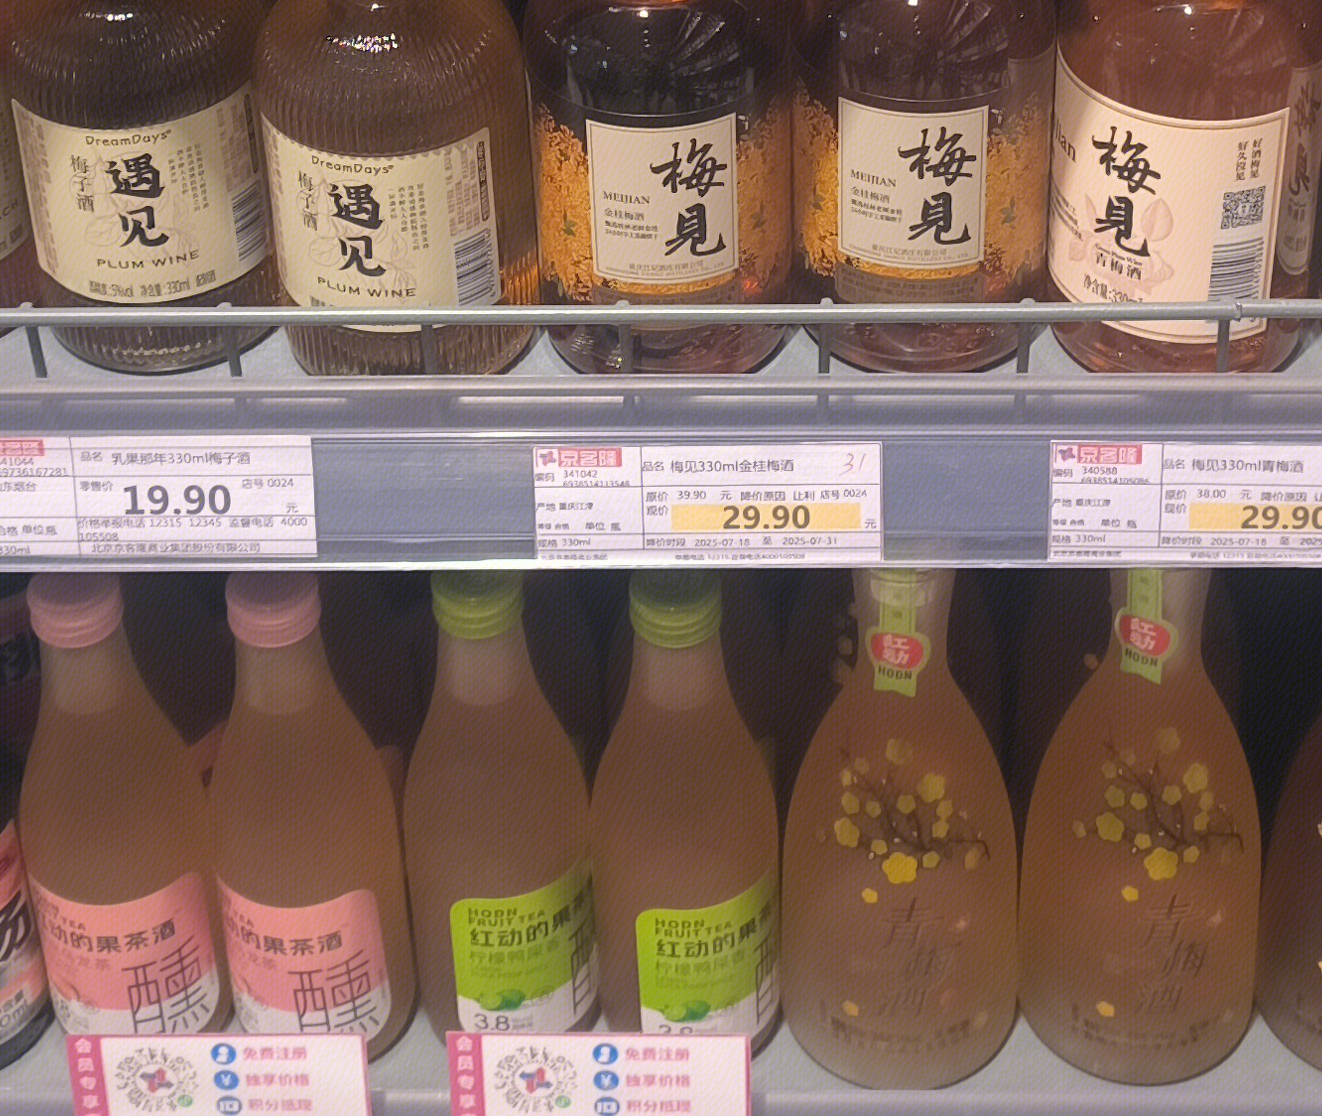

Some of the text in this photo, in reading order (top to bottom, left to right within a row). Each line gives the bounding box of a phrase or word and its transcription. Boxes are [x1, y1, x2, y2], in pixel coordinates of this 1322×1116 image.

[85, 131, 165, 147] DreamDays
[311, 155, 389, 176] DreamDays
[70, 153, 95, 214] 梅子酒
[850, 168, 897, 188] MEIJIAN
[106, 153, 170, 249] 遇见
[602, 190, 650, 205] MEIJIAN
[327, 184, 386, 278] 遇见
[97, 250, 200, 270] PLUM WINE
[317, 277, 417, 298] PLUM WINE
[670, 459, 794, 473] 梅见330ml金桂梅酒
[1192, 459, 1304, 473] 梅见330ml青梅酒
[123, 484, 231, 516] 19.90
[722, 505, 810, 530] 29.90
[1124, 648, 1159, 667] HODN
[878, 666, 912, 680] HODN
[468, 907, 518, 918] HODN
[518, 910, 546, 924] TEA
[655, 918, 705, 929] HODN
[707, 921, 732, 934] TEA
[474, 1013, 511, 1031] 3.8
[243, 1048, 308, 1061] 免费注册
[625, 1048, 690, 1061] 免费注册
